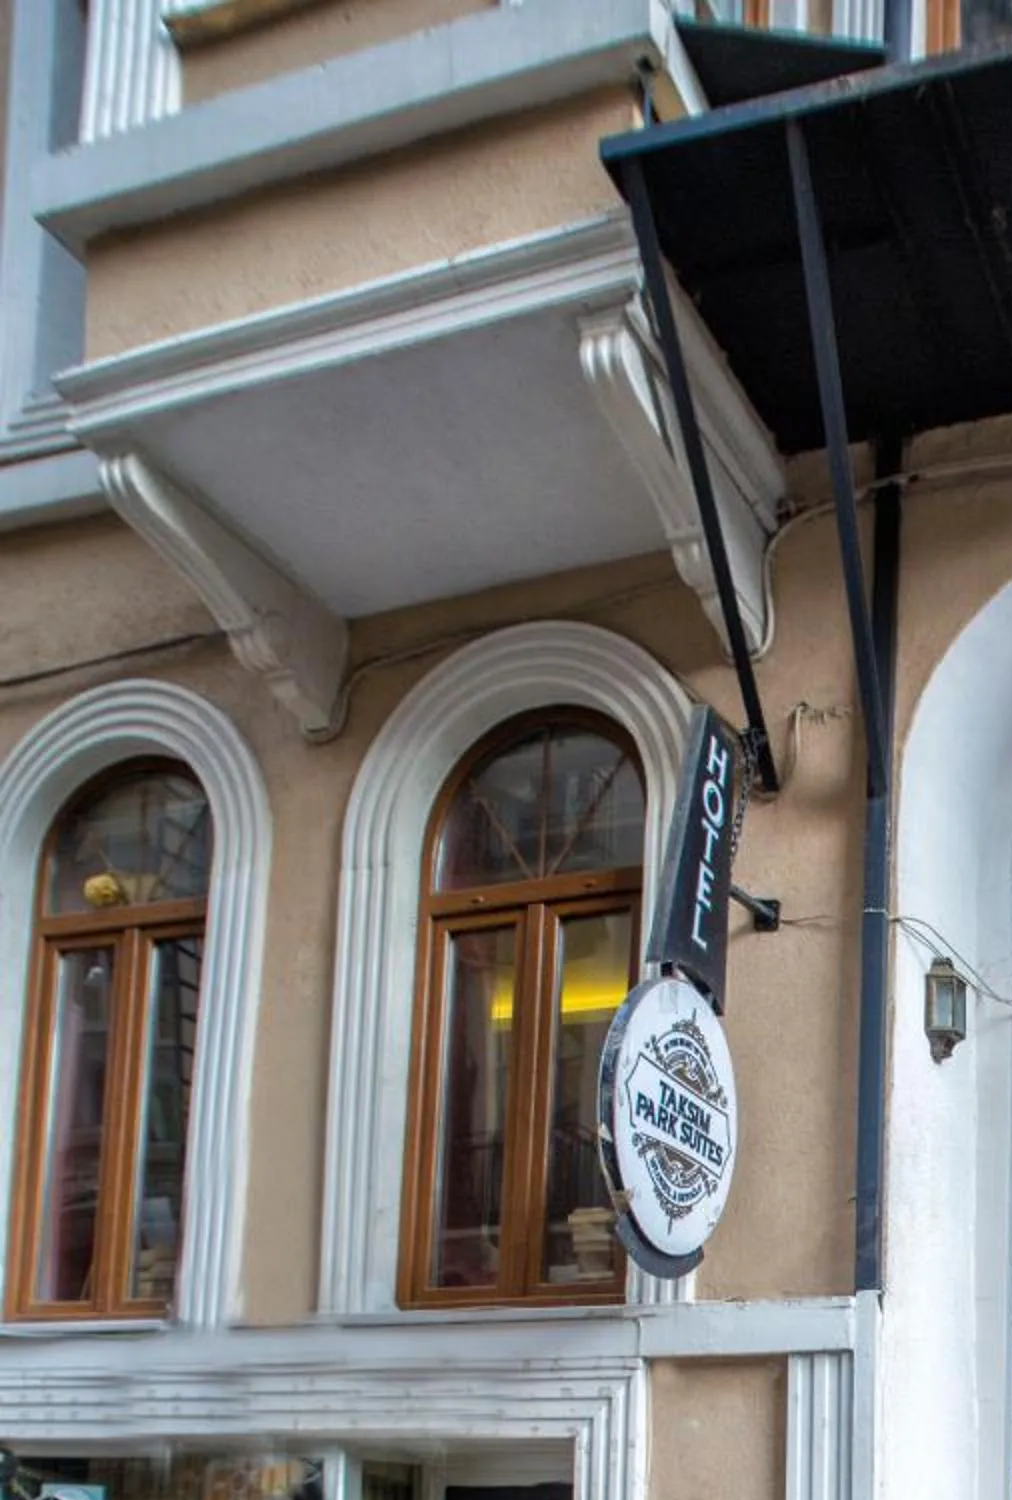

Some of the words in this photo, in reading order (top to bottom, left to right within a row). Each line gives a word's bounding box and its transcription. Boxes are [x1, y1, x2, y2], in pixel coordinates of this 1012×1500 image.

[691, 734, 728, 950] HOTEL
[636, 1091, 679, 1139] PARK
[680, 1121, 723, 1166] SUITES
[659, 1080, 711, 1134] TAKSIM
